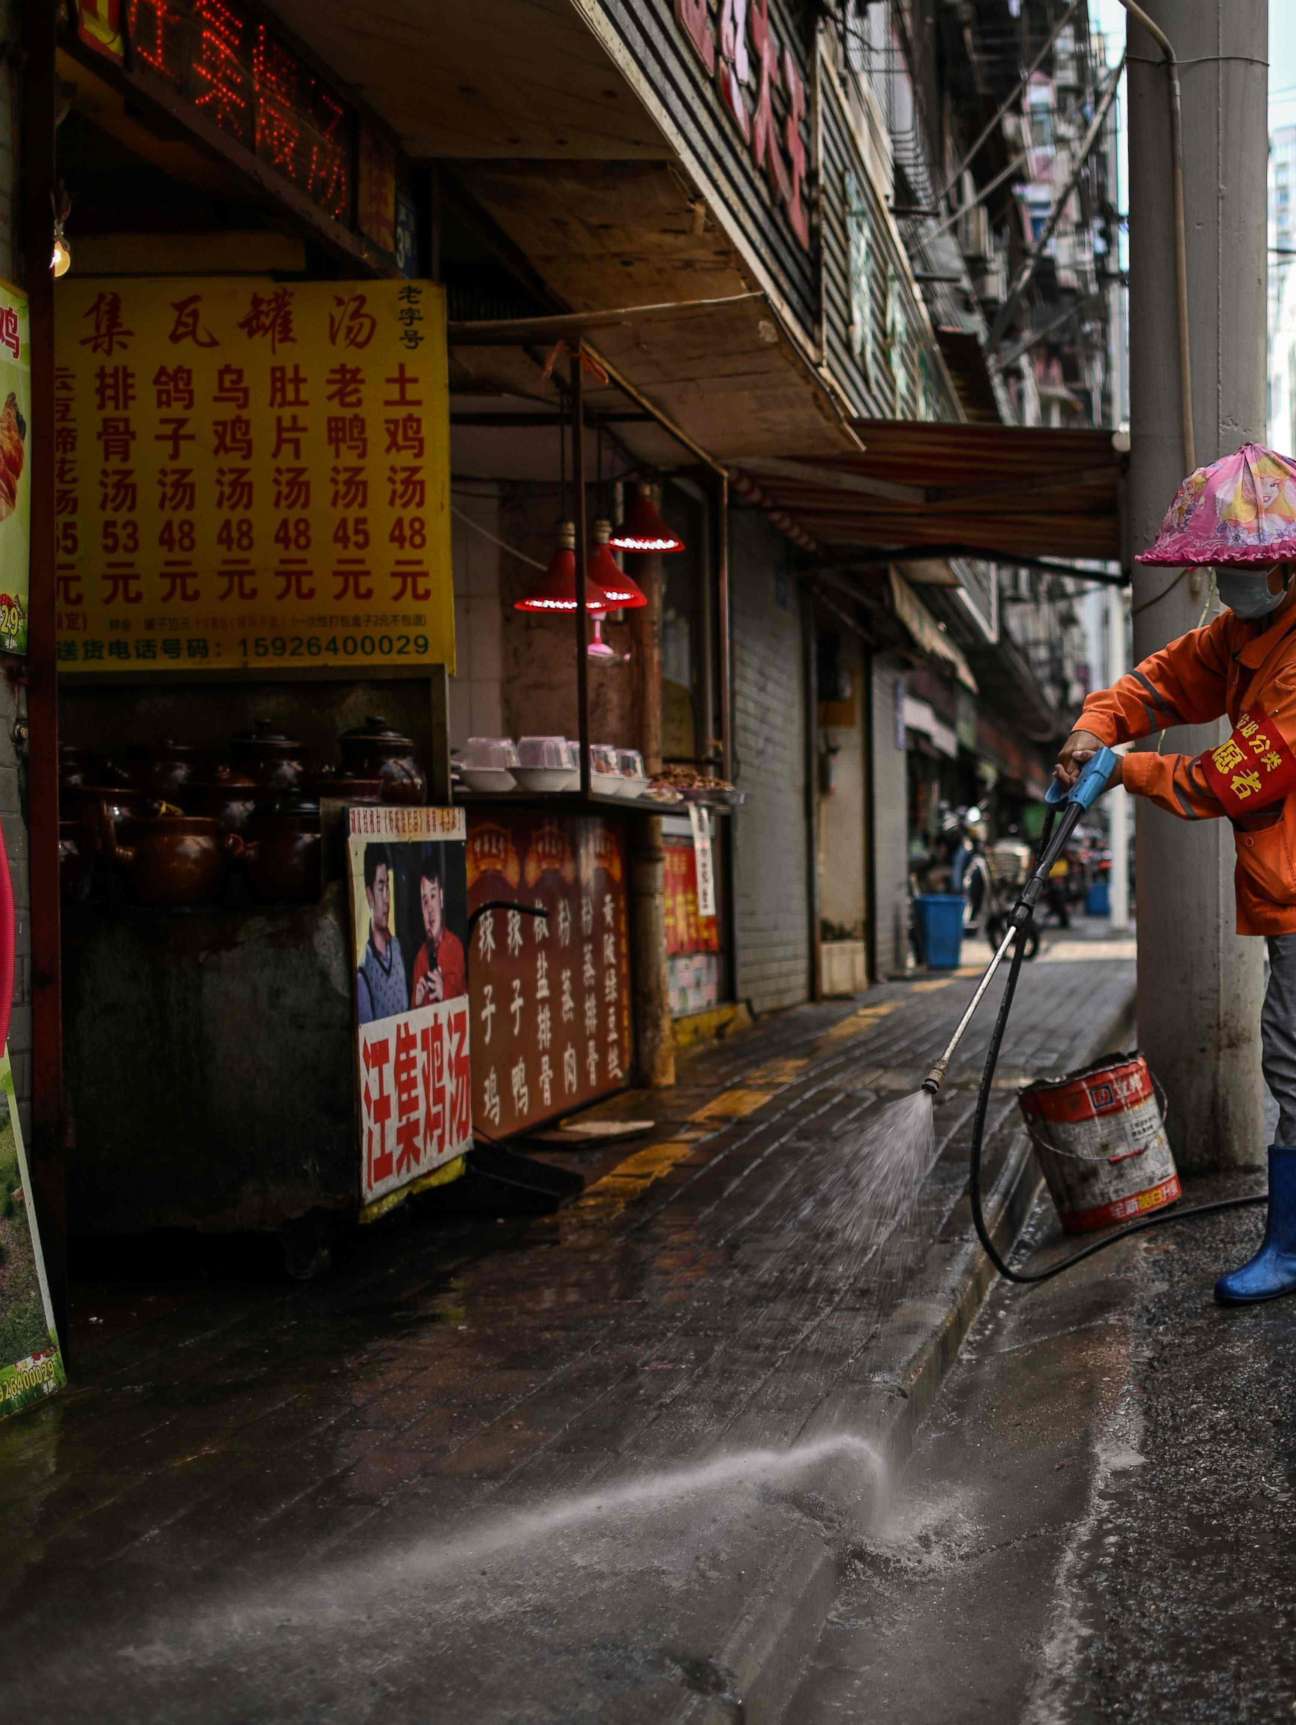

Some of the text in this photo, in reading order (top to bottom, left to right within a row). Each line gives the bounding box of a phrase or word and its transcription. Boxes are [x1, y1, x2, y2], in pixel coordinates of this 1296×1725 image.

[397, 284, 425, 351] 老字号
[238, 634, 430, 658] 15926400029
[362, 1010, 473, 1192] 汪集鸡汤
